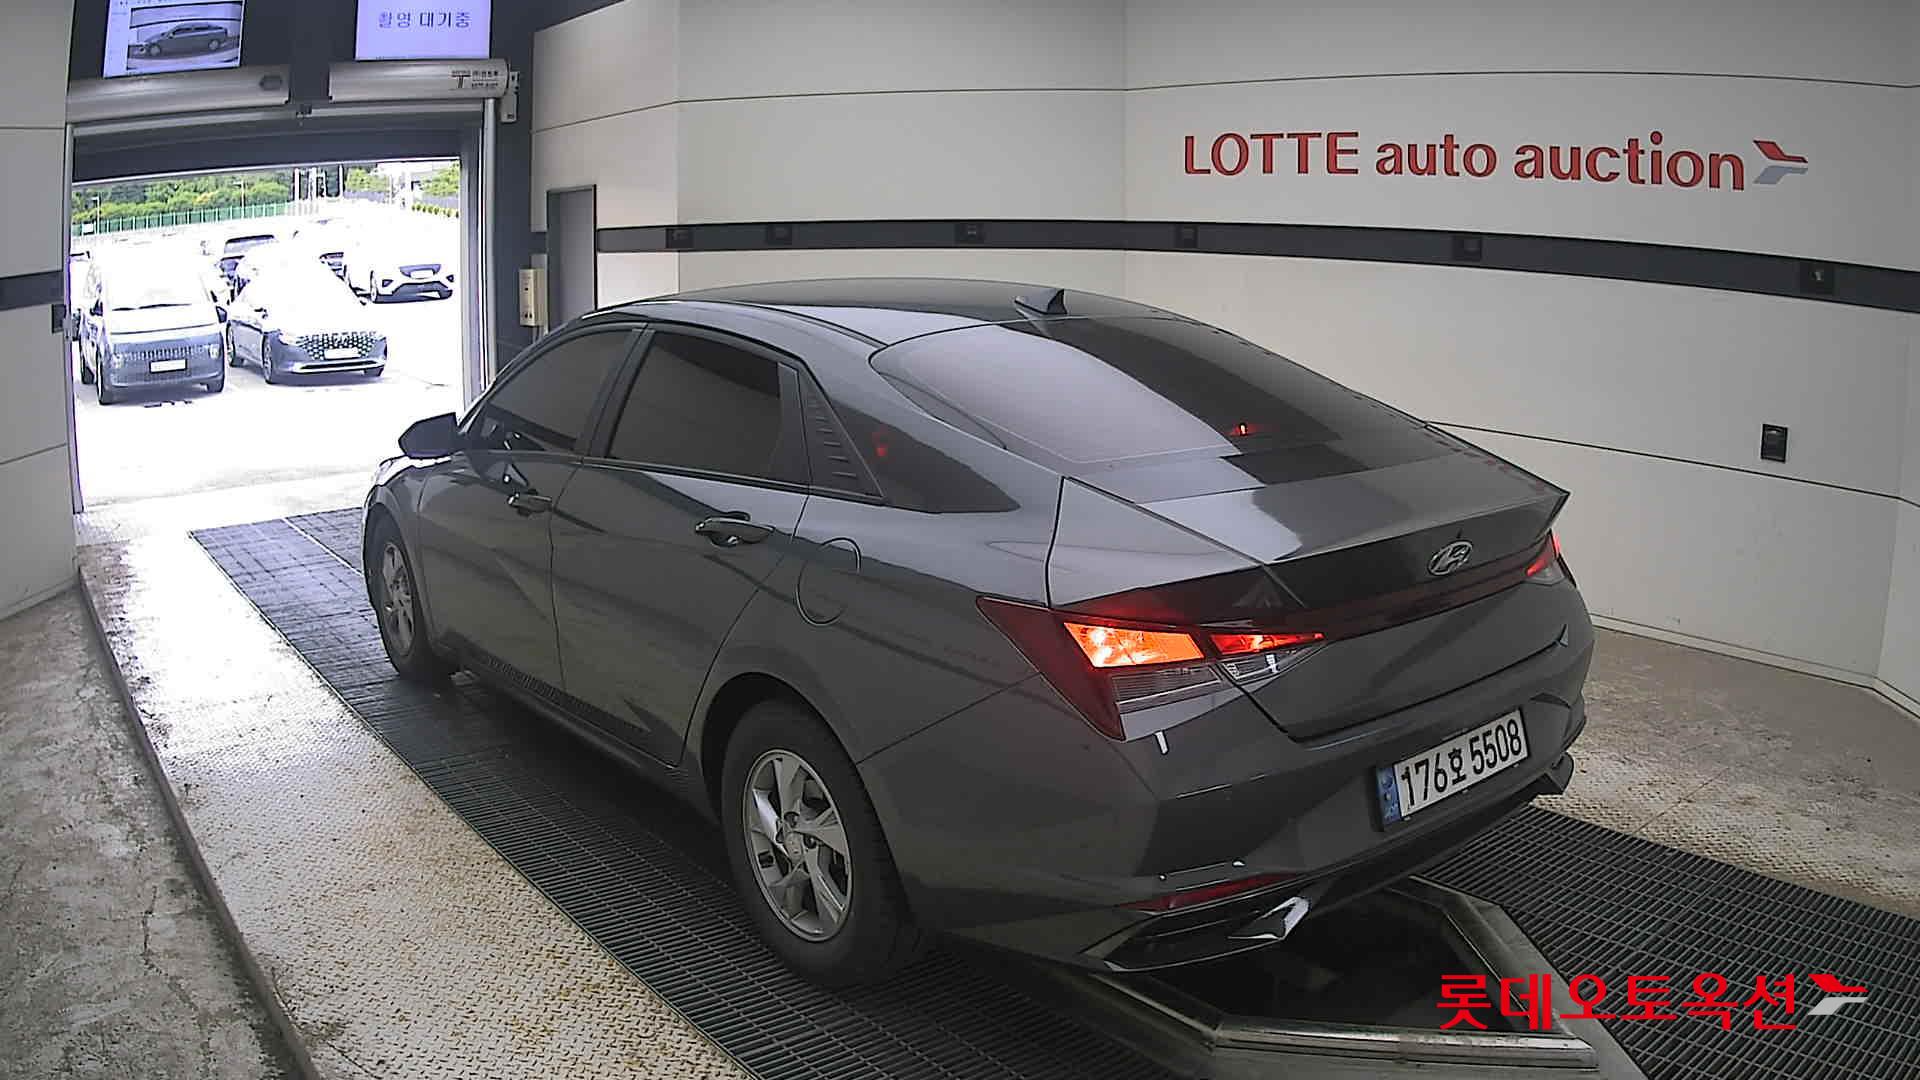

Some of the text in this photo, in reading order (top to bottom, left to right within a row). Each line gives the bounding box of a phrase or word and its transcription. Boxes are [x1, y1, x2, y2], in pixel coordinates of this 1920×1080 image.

[419, 11, 471, 29] 대기중
[1184, 130, 1745, 191] LOTTE auto auction
